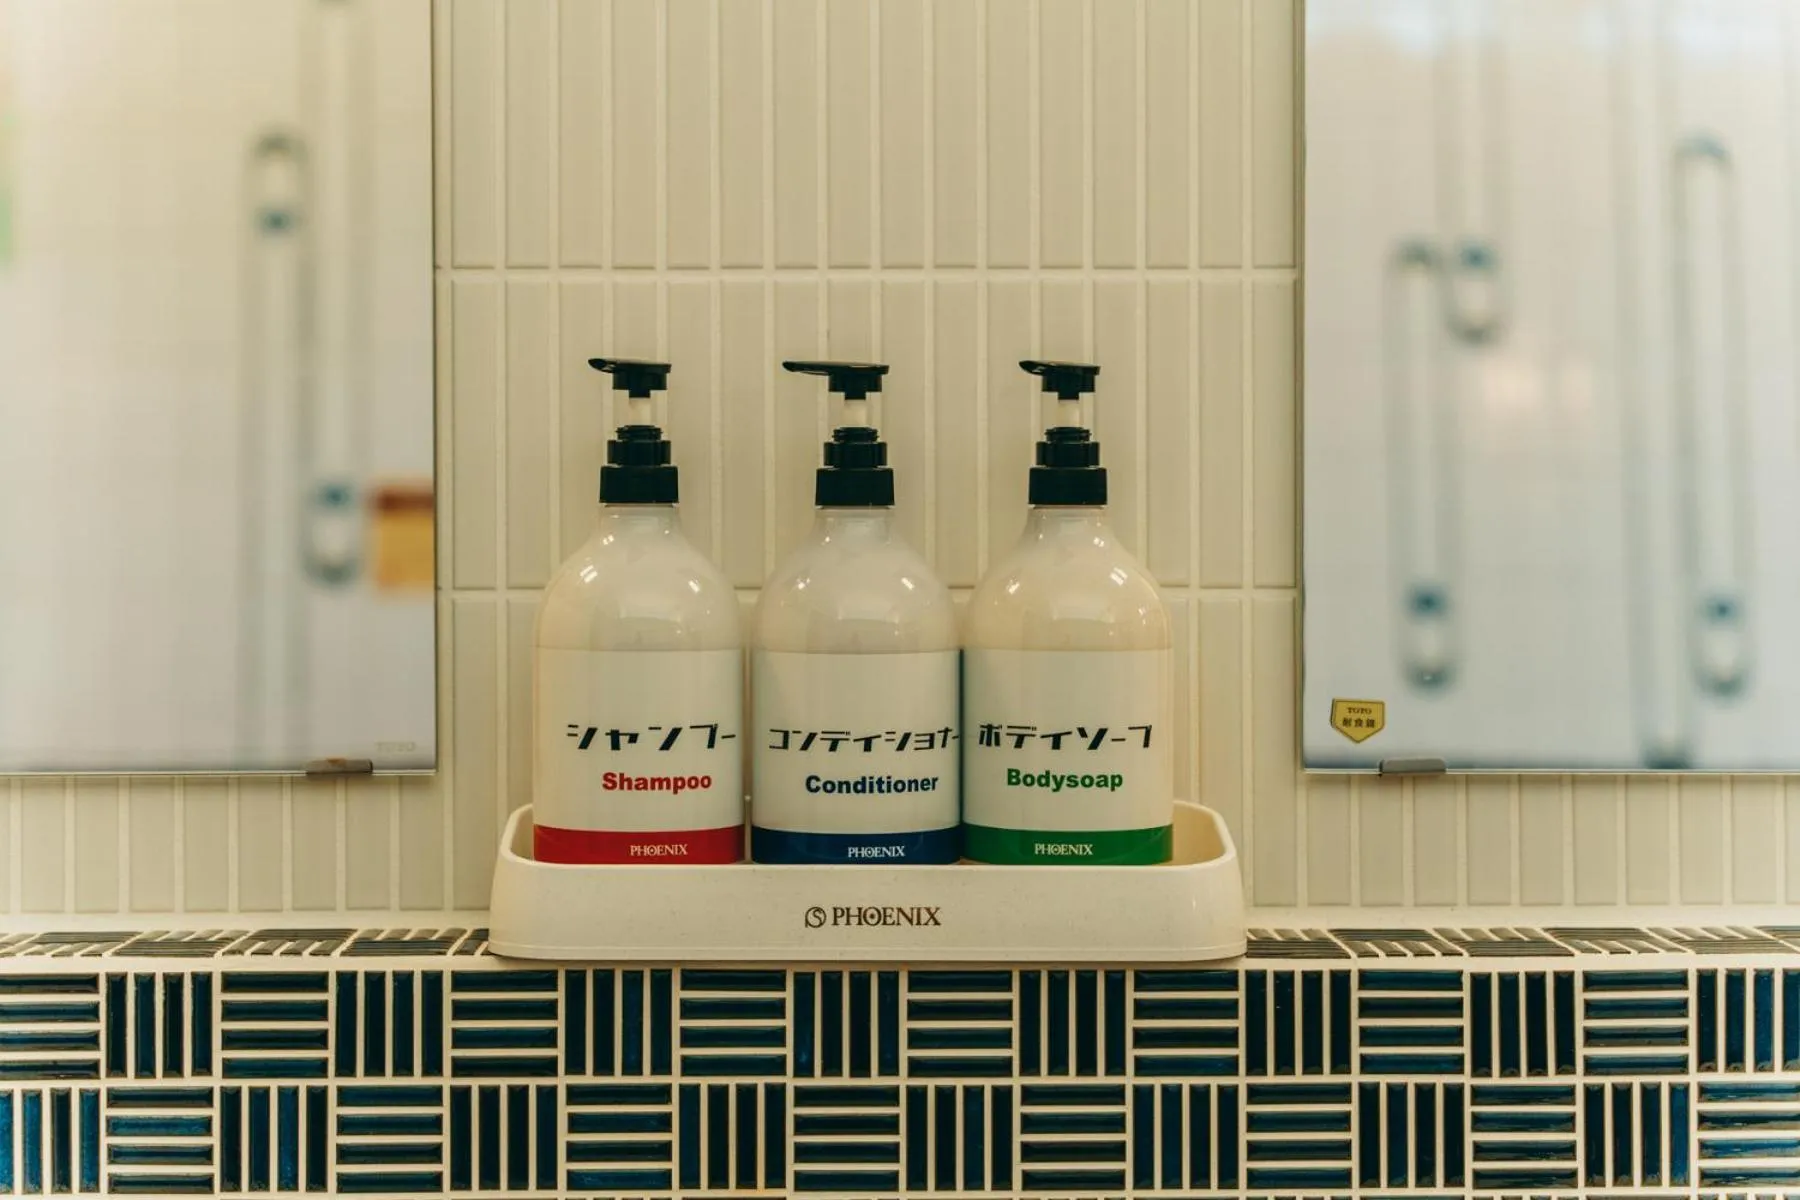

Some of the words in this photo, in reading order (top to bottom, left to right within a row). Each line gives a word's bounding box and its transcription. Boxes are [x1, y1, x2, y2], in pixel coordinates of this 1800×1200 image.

[567, 723, 737, 751] シャンプー
[978, 723, 1153, 751] ボディソープ
[602, 771, 712, 795] Shampoo
[805, 774, 939, 795] Conditioner
[1006, 767, 1124, 793] Bodysoap
[630, 843, 688, 857] PHOENIX
[847, 845, 906, 859] PHOENIX
[1034, 842, 1094, 857] PHOENIX
[831, 906, 942, 927] PHOENIX
